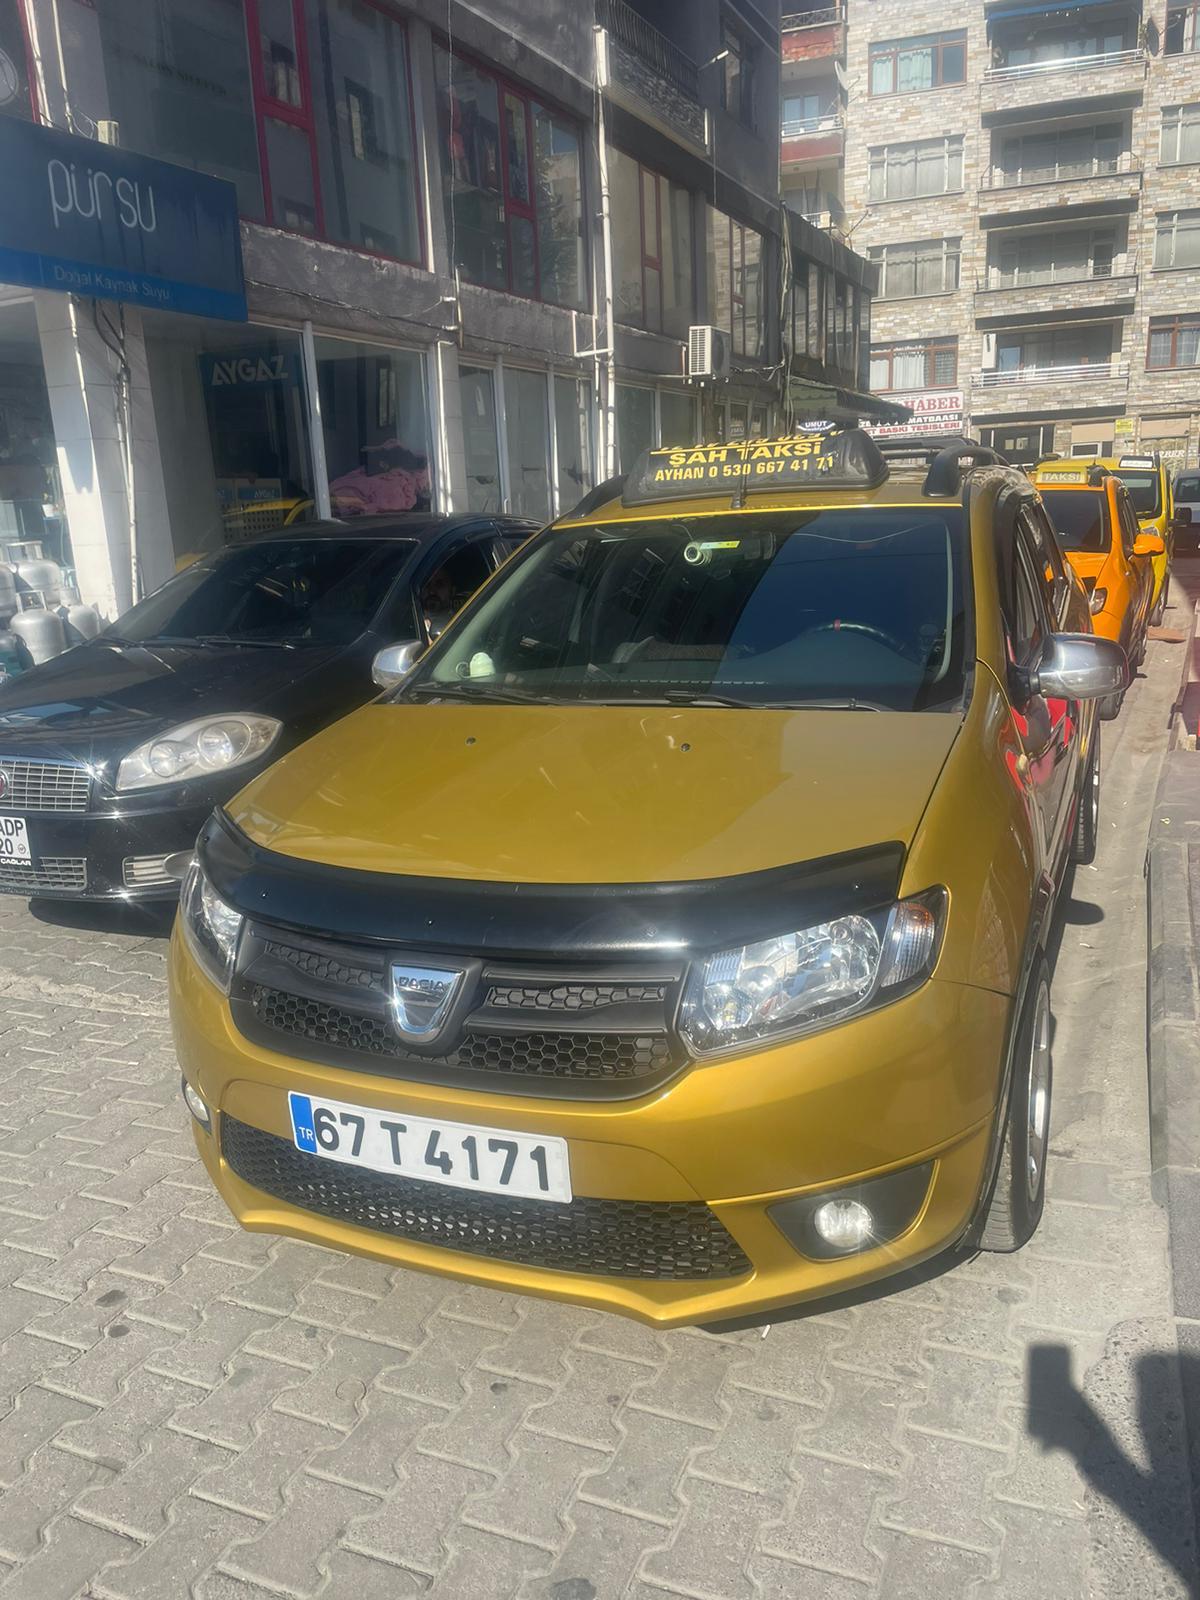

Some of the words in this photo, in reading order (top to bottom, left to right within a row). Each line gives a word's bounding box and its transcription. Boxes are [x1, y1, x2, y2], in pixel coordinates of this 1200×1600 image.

[95, 273, 138, 294] Kaynak
[142, 282, 171, 301] Suyu
[211, 355, 289, 386] AYGAZ
[804, 420, 828, 428] UMUT
[879, 426, 908, 434] BASKI
[655, 466, 704, 482] AYHAN
[709, 466, 717, 478] 0
[756, 460, 785, 474] 667
[790, 458, 807, 472] 41
[816, 455, 834, 469] 71
[399, 976, 445, 991] DACIA
[298, 1126, 314, 1141] TR
[313, 1108, 365, 1157] 67
[380, 1121, 407, 1166] T
[424, 1130, 549, 1191] 4171
